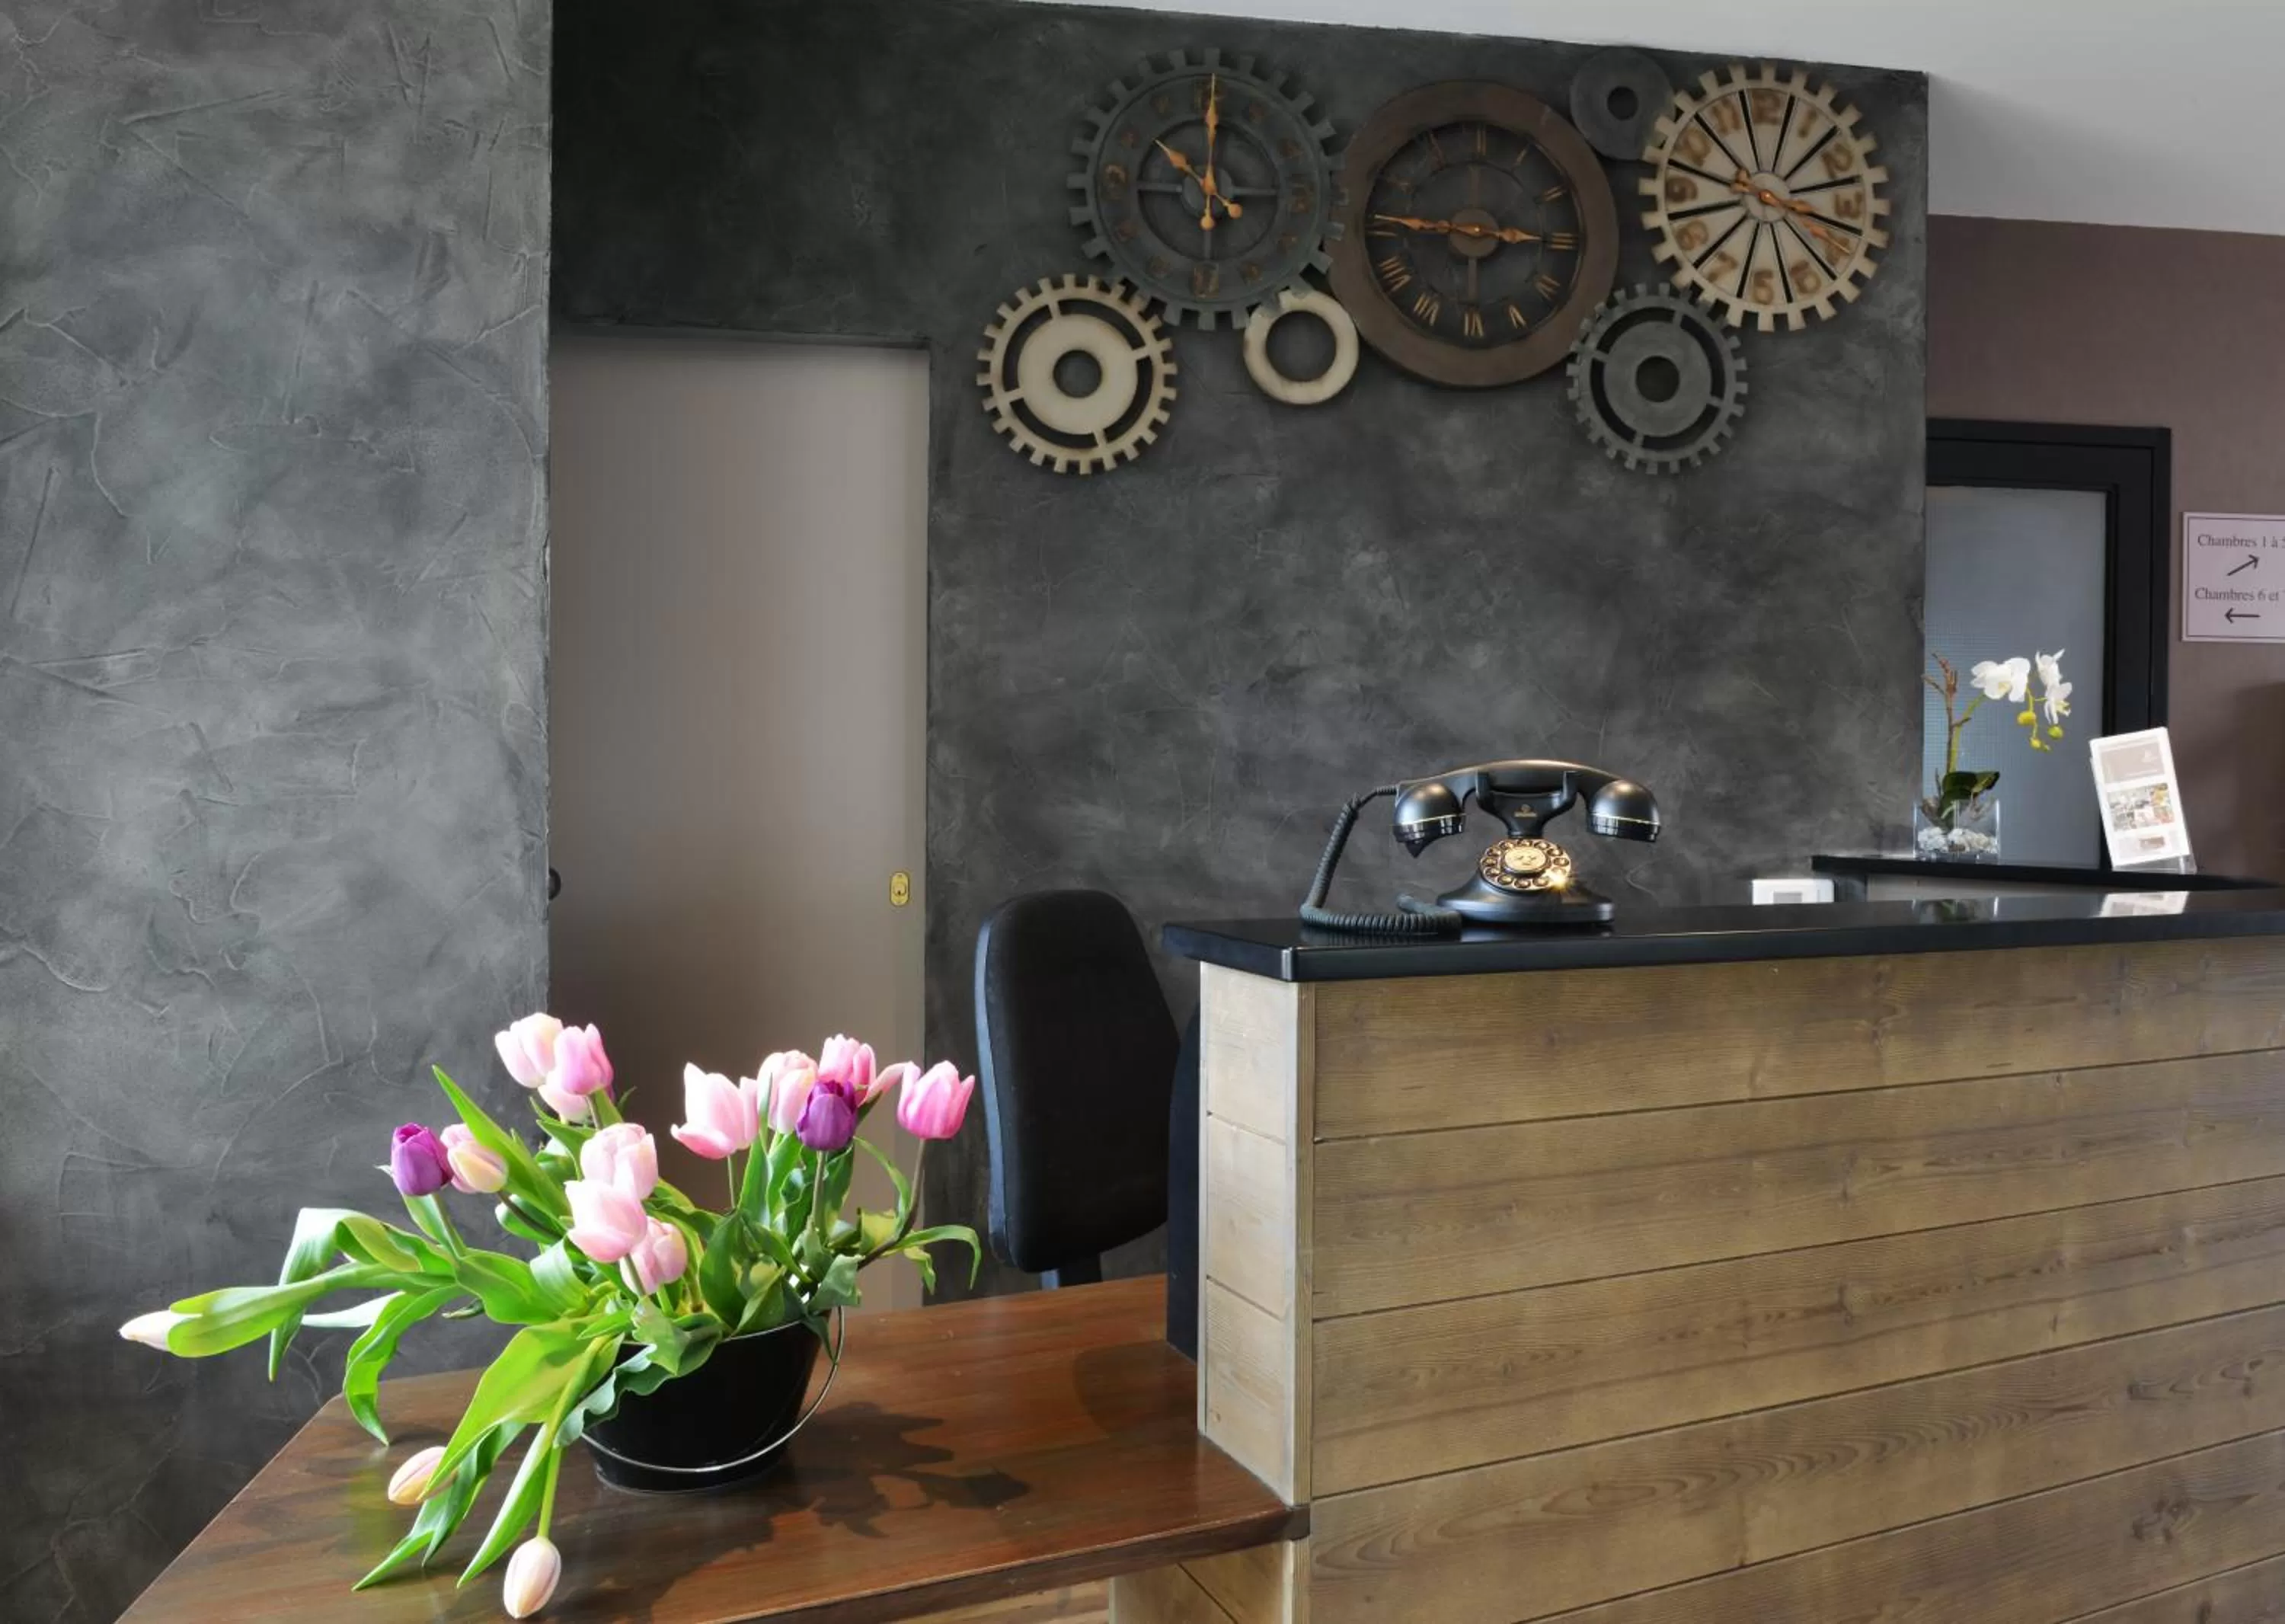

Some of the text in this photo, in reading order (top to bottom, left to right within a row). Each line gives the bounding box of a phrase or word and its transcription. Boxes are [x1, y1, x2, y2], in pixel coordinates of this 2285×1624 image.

[2197, 534, 2257, 548] Chambres
[2270, 535, 2278, 548] à
[2194, 587, 2255, 601] Chambres
[2257, 589, 2266, 601] 6
[2267, 590, 2280, 602] et
